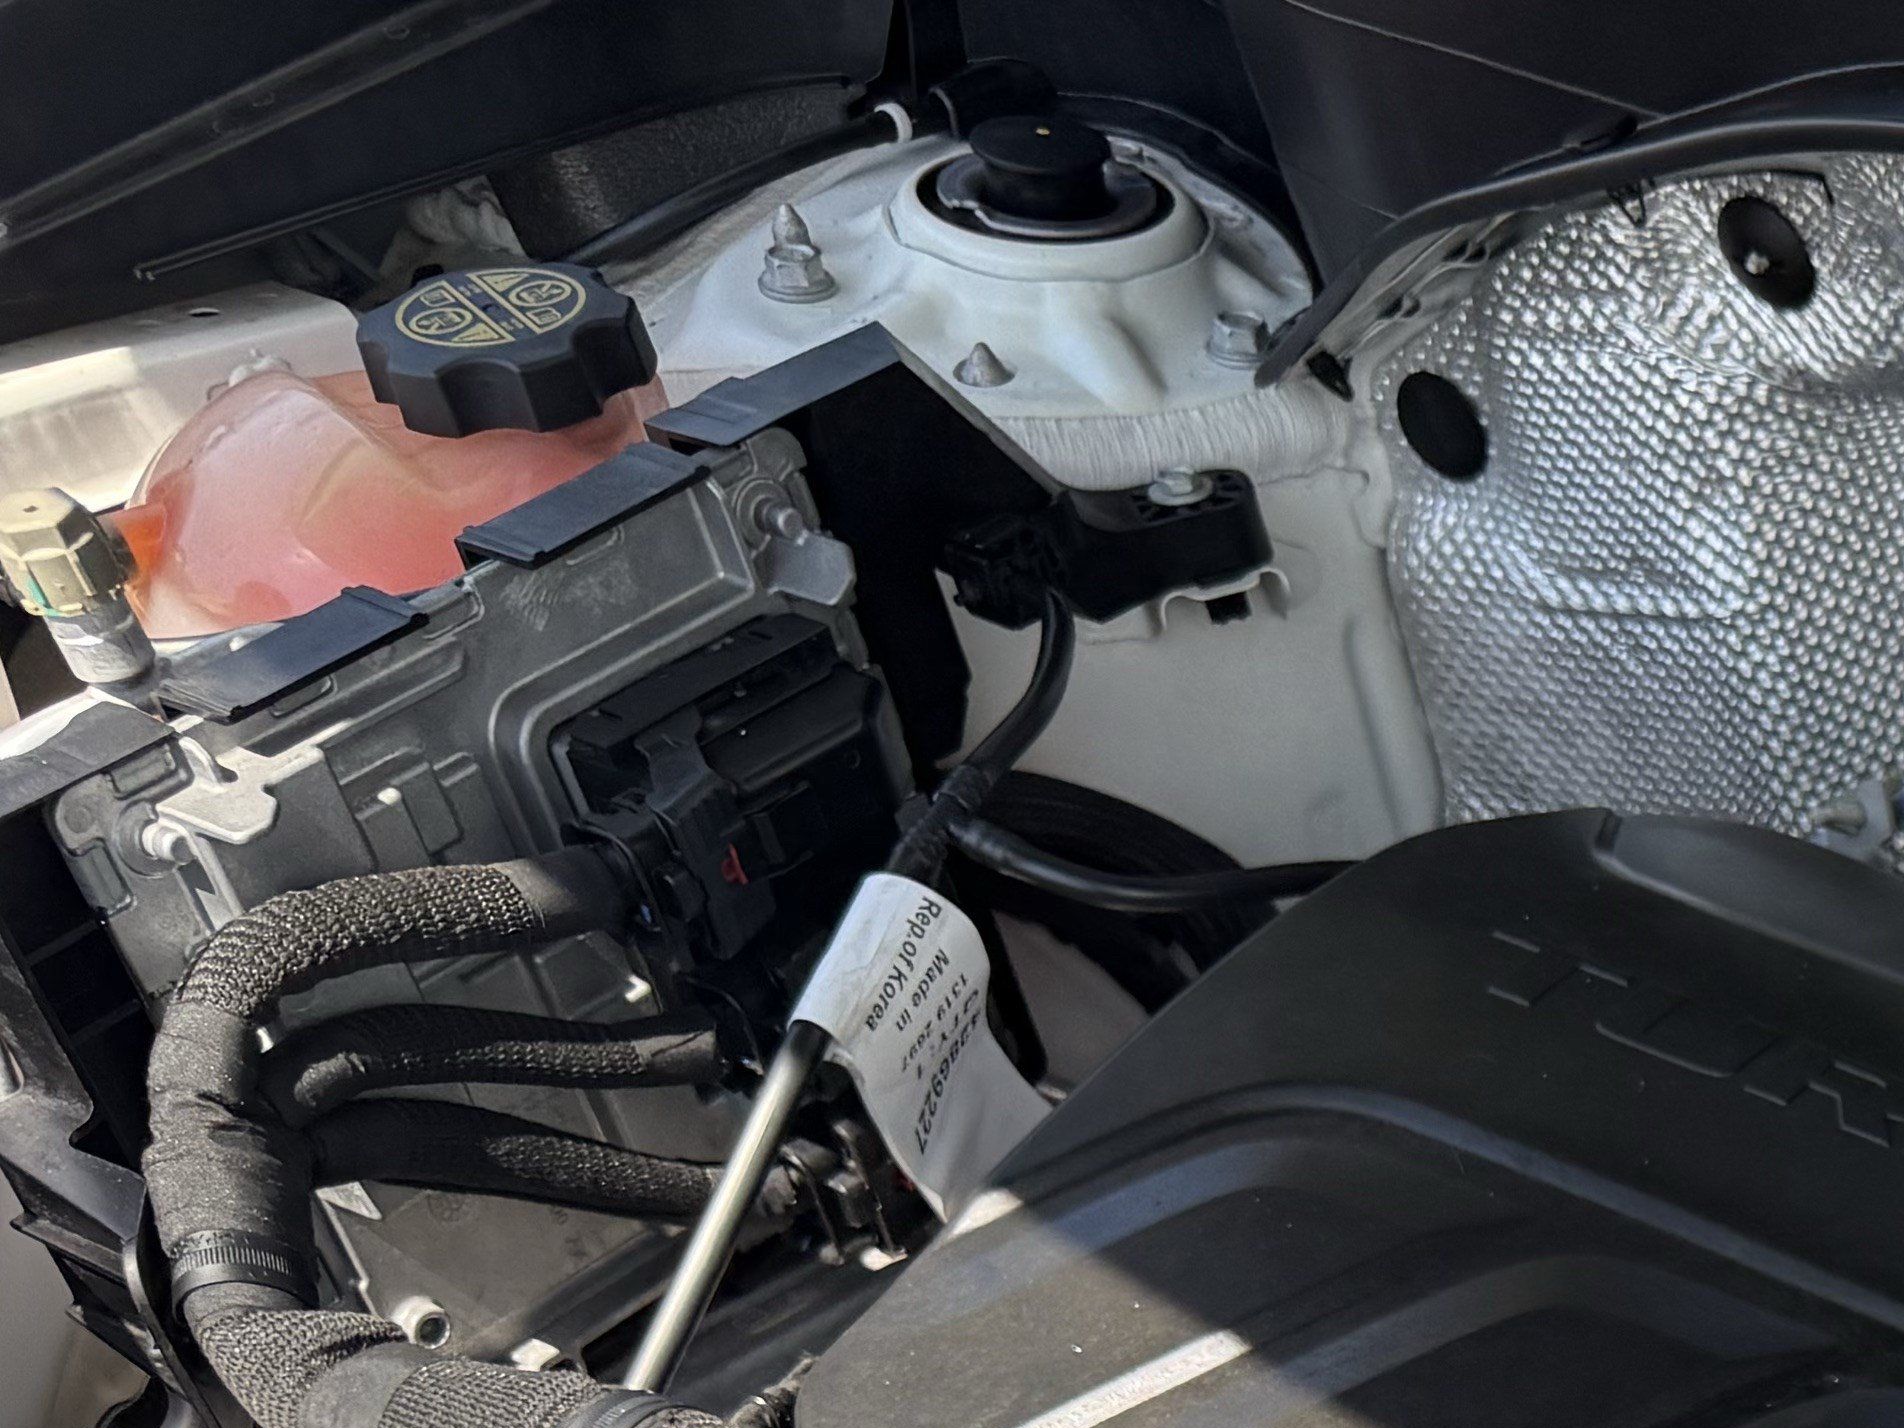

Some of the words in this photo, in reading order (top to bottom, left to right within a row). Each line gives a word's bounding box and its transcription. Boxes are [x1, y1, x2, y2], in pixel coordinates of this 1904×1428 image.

[865, 965, 909, 1032] Korea
[912, 948, 950, 1008] Made
[895, 1008, 913, 1032] in
